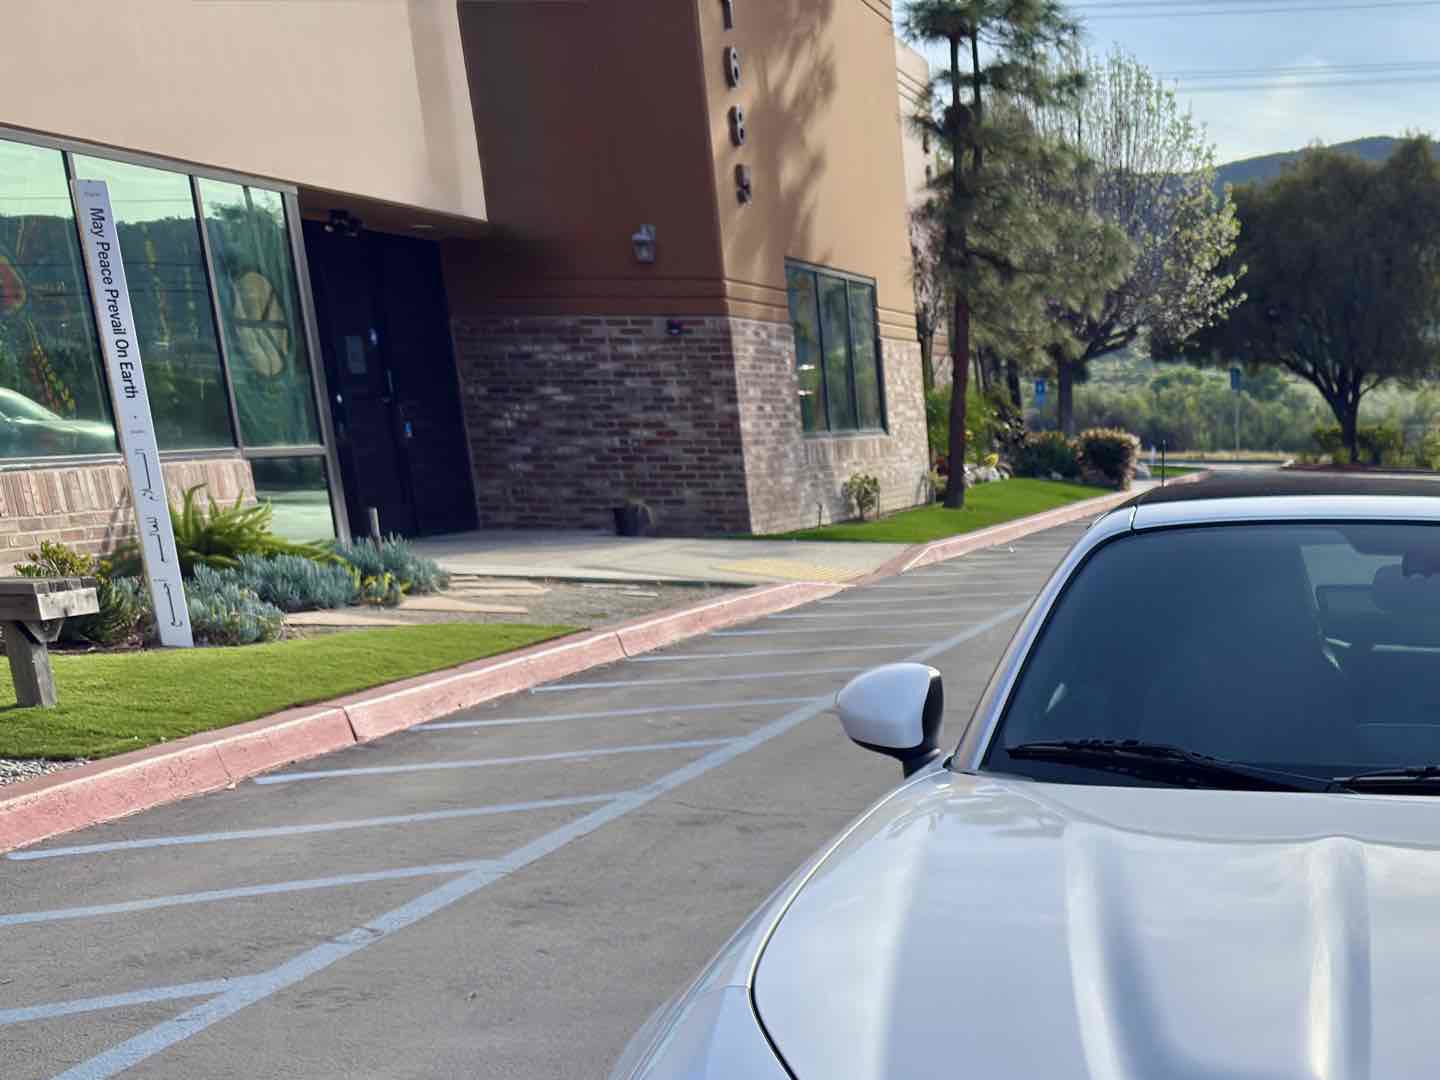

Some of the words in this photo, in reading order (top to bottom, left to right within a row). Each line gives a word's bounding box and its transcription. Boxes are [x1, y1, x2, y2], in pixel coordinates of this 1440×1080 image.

[89, 207, 106, 238] May
[96, 241, 113, 285] Peace
[104, 289, 127, 335] Prevail
[115, 339, 129, 358] On
[120, 361, 139, 399] Earth
